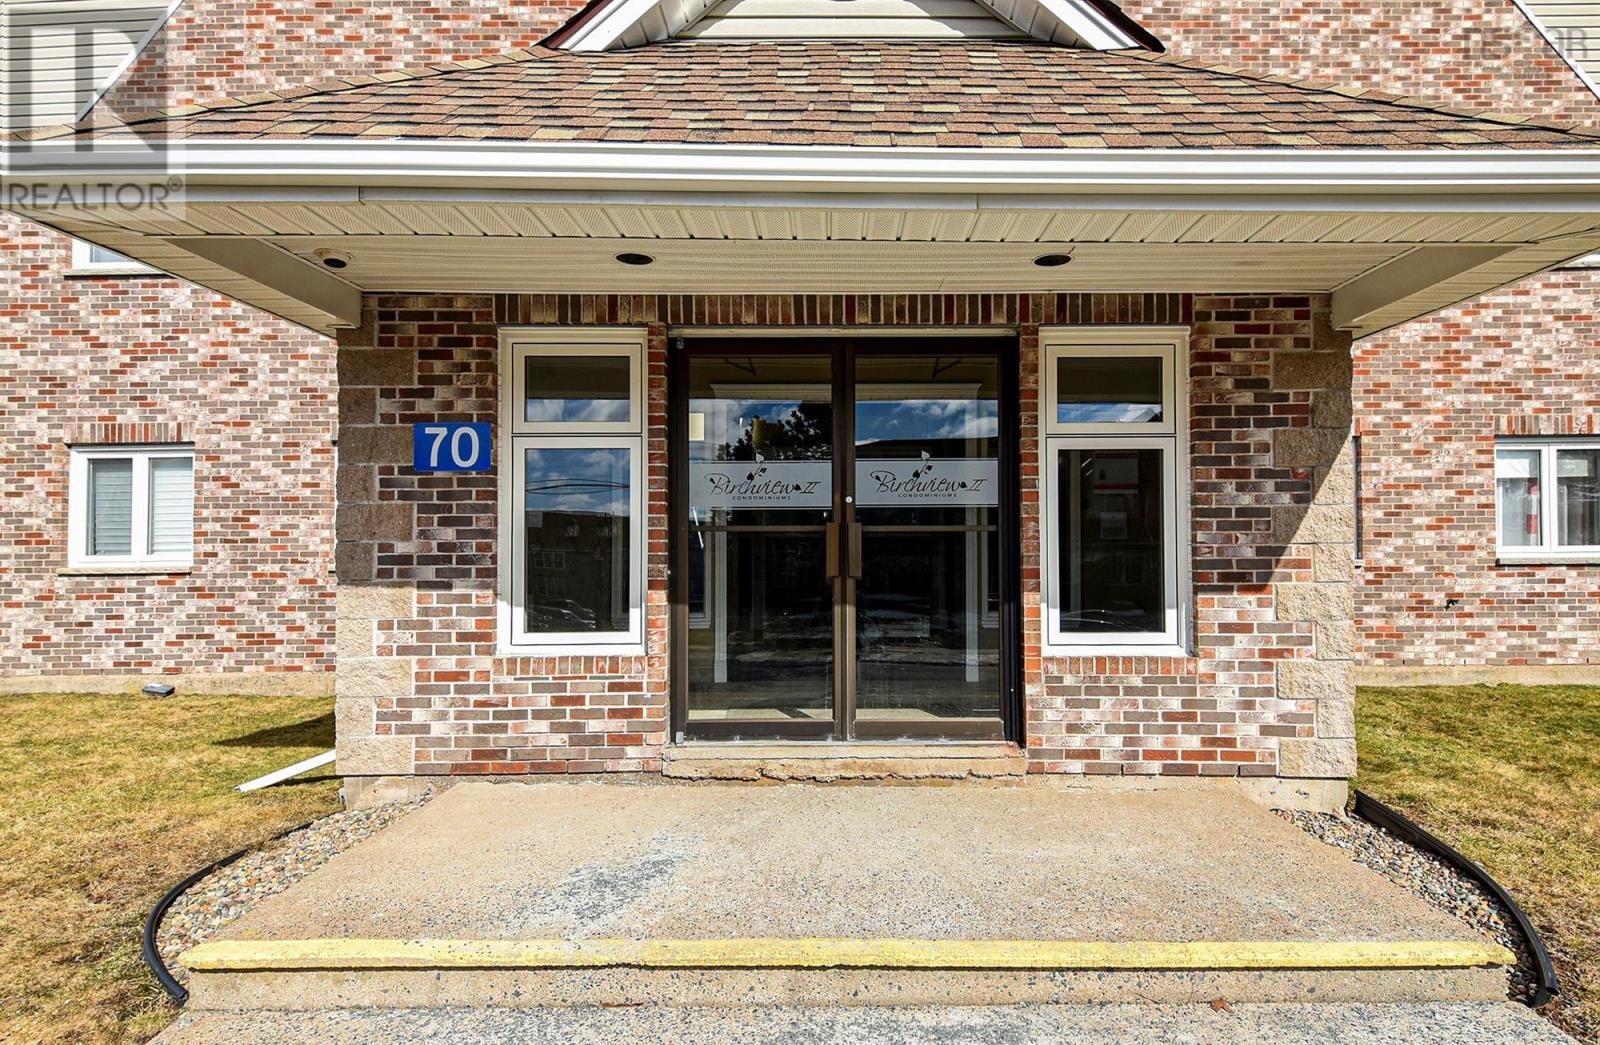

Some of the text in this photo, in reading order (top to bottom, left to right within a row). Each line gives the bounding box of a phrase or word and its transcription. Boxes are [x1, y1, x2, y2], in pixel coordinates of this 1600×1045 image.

[424, 426, 480, 468] 70
[704, 472, 795, 496] Birchview
[870, 470, 960, 493] Birchview
